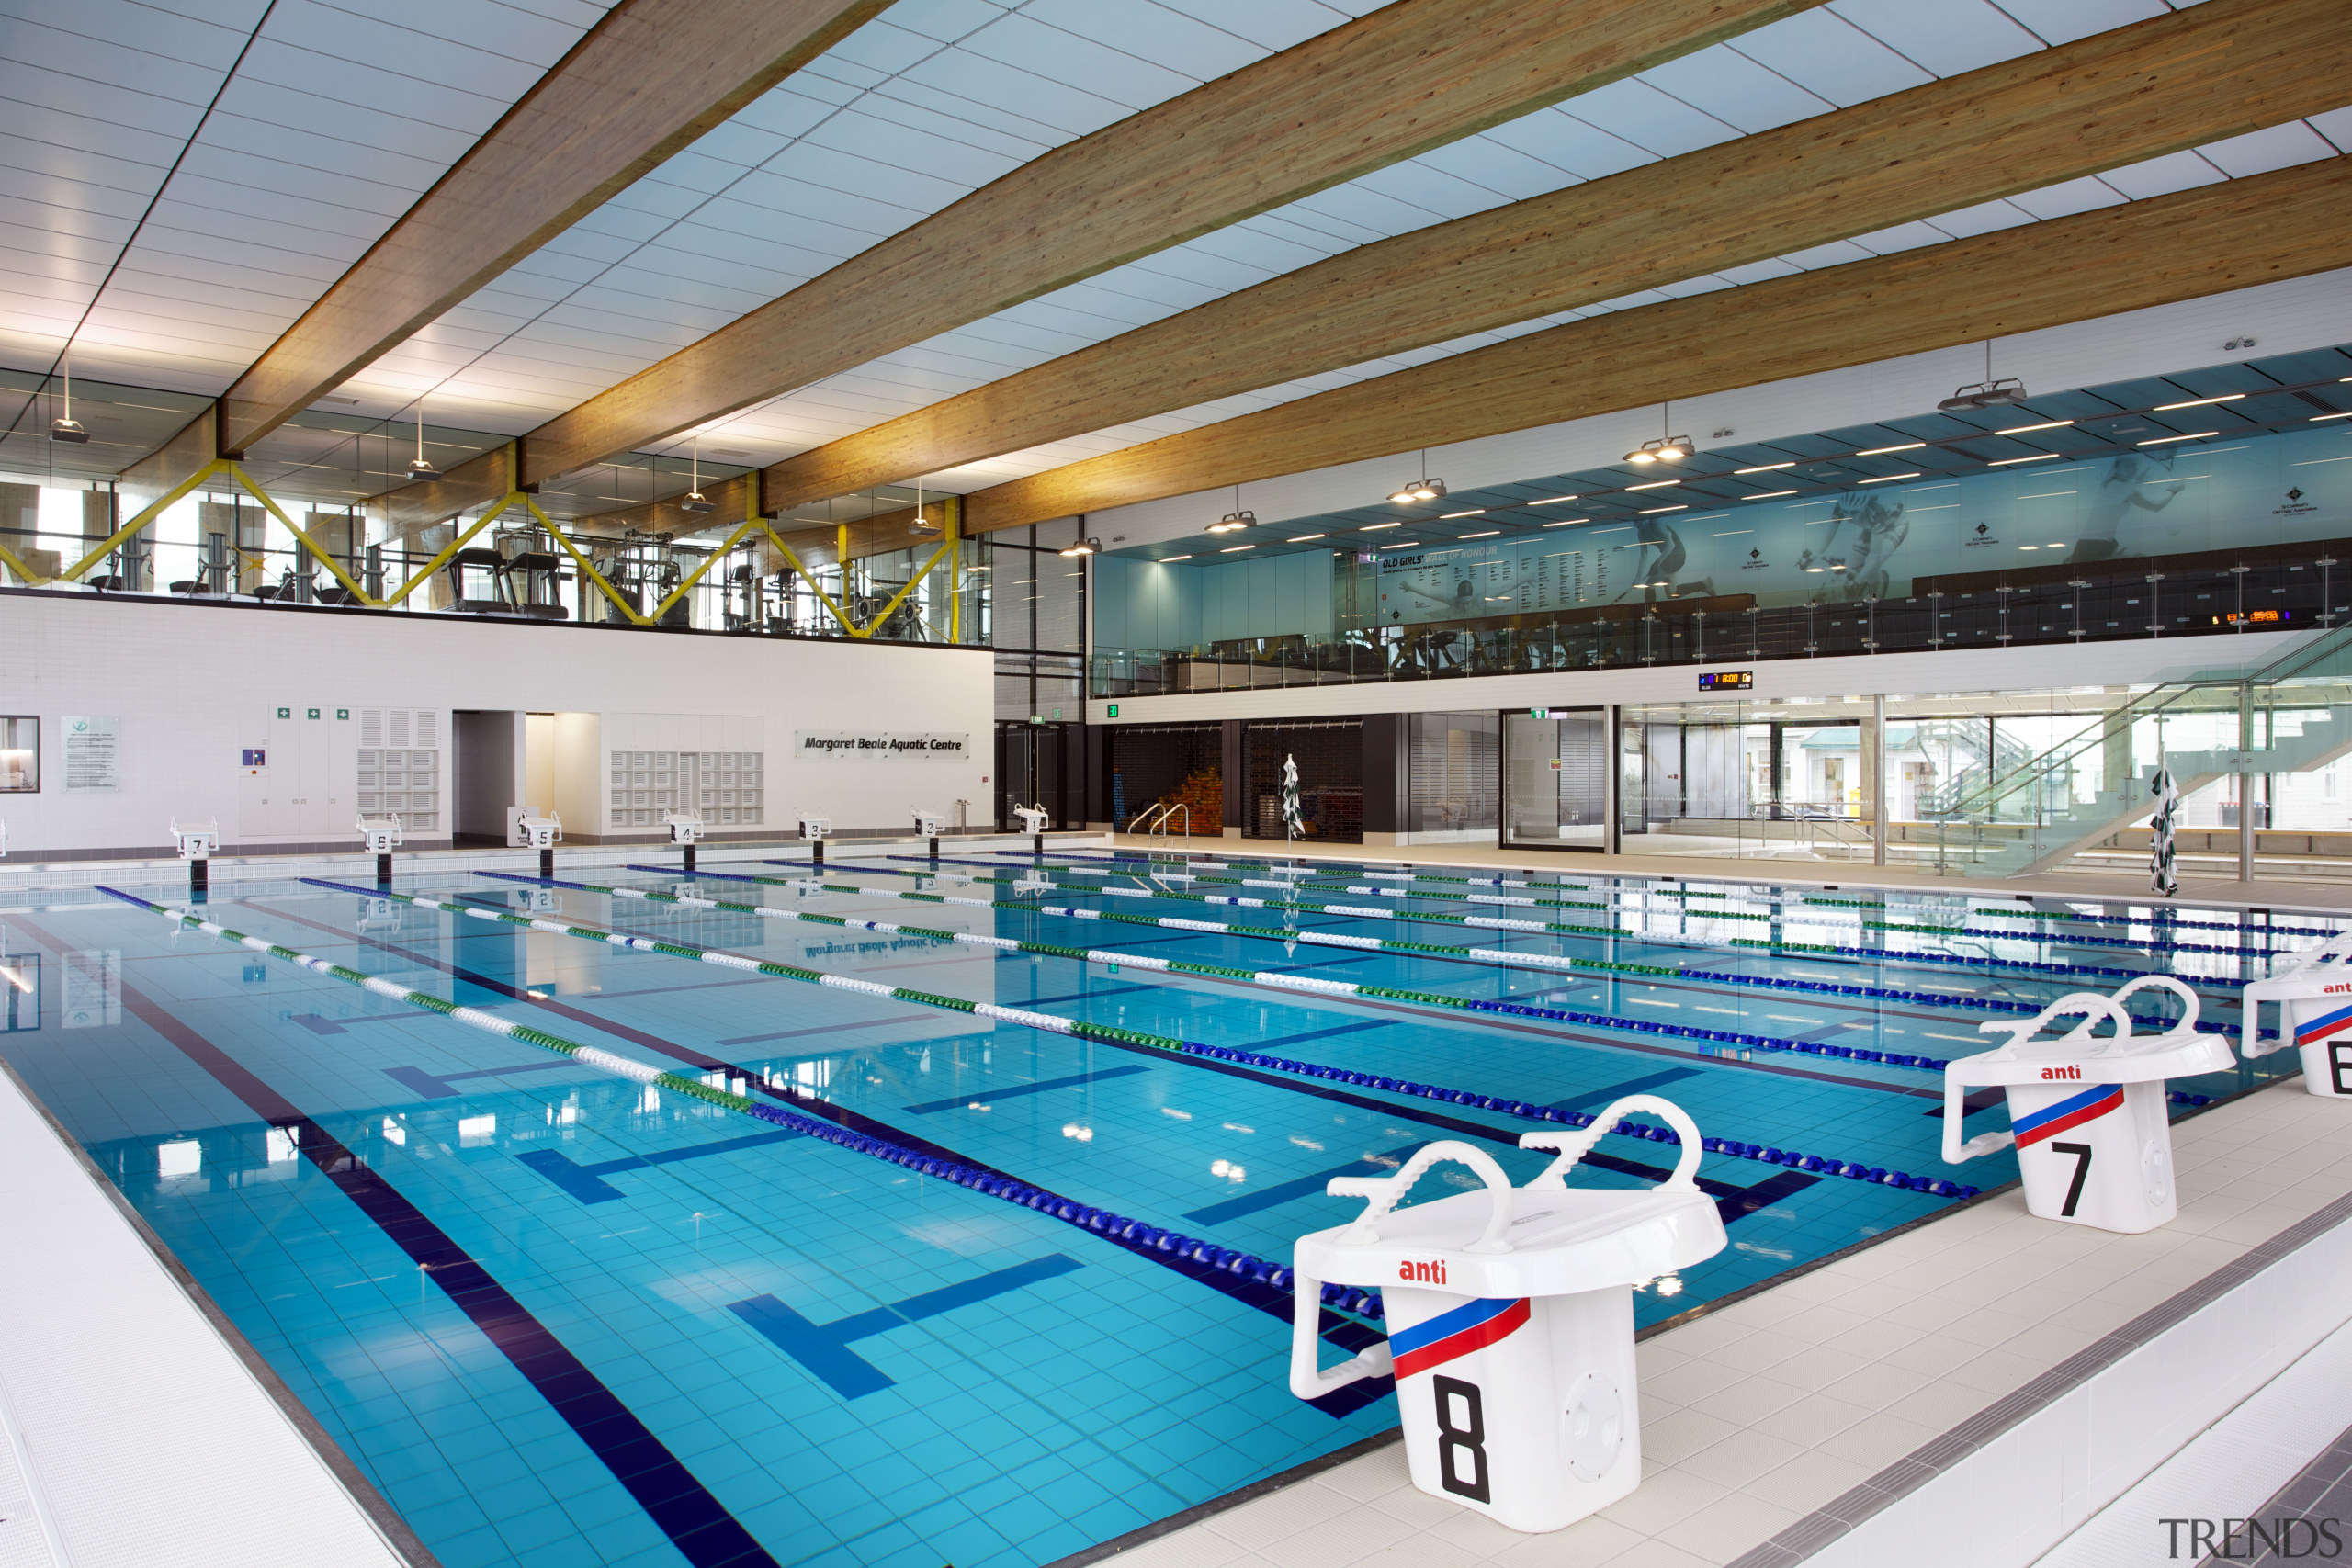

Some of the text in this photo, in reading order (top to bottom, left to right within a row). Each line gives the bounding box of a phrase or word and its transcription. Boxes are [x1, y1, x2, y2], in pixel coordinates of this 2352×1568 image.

[1383, 558, 1397, 569] OLD
[1399, 555, 1424, 566] GIRLS'
[1425, 553, 1447, 563] WALL
[1449, 551, 1461, 560] OF
[1461, 546, 1498, 558] HONOUR
[805, 737, 962, 752] Margaret Beale Aquatic Centre
[539, 832, 548, 844] 5
[193, 840, 201, 854] 7
[2324, 982, 2352, 993] ant
[2041, 1064, 2081, 1079] anti
[2052, 1141, 2092, 1217] 7
[1399, 1258, 1446, 1285] anti
[1432, 1374, 1490, 1505] 8
